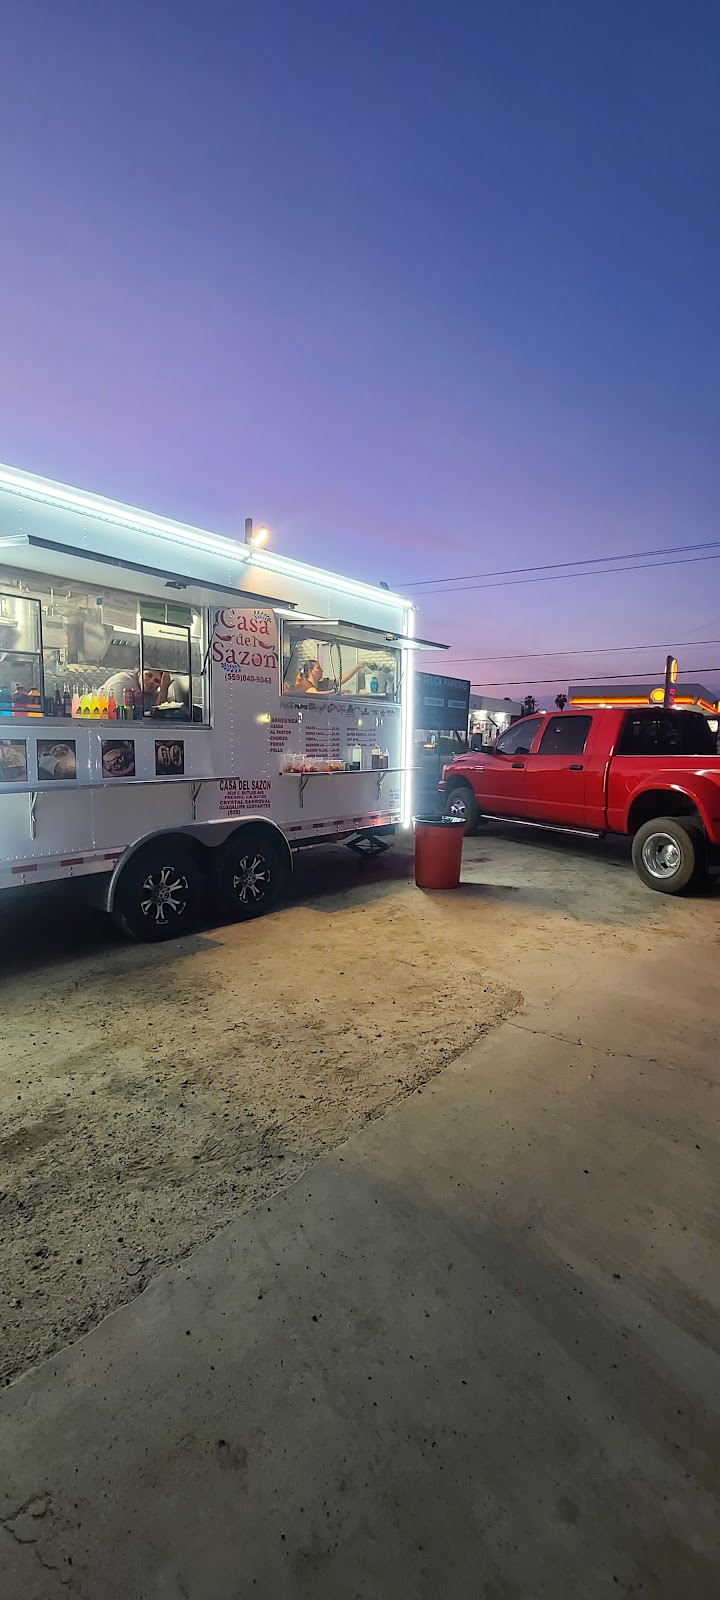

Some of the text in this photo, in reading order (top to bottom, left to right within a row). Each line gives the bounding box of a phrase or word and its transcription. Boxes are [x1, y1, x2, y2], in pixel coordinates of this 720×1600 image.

[220, 608, 269, 635] Casa
[235, 634, 256, 647] del
[212, 642, 277, 668] Sazon
[423, 675, 467, 690] TRUCK PARKING
[220, 780, 271, 790] CASA DEL SAZON
